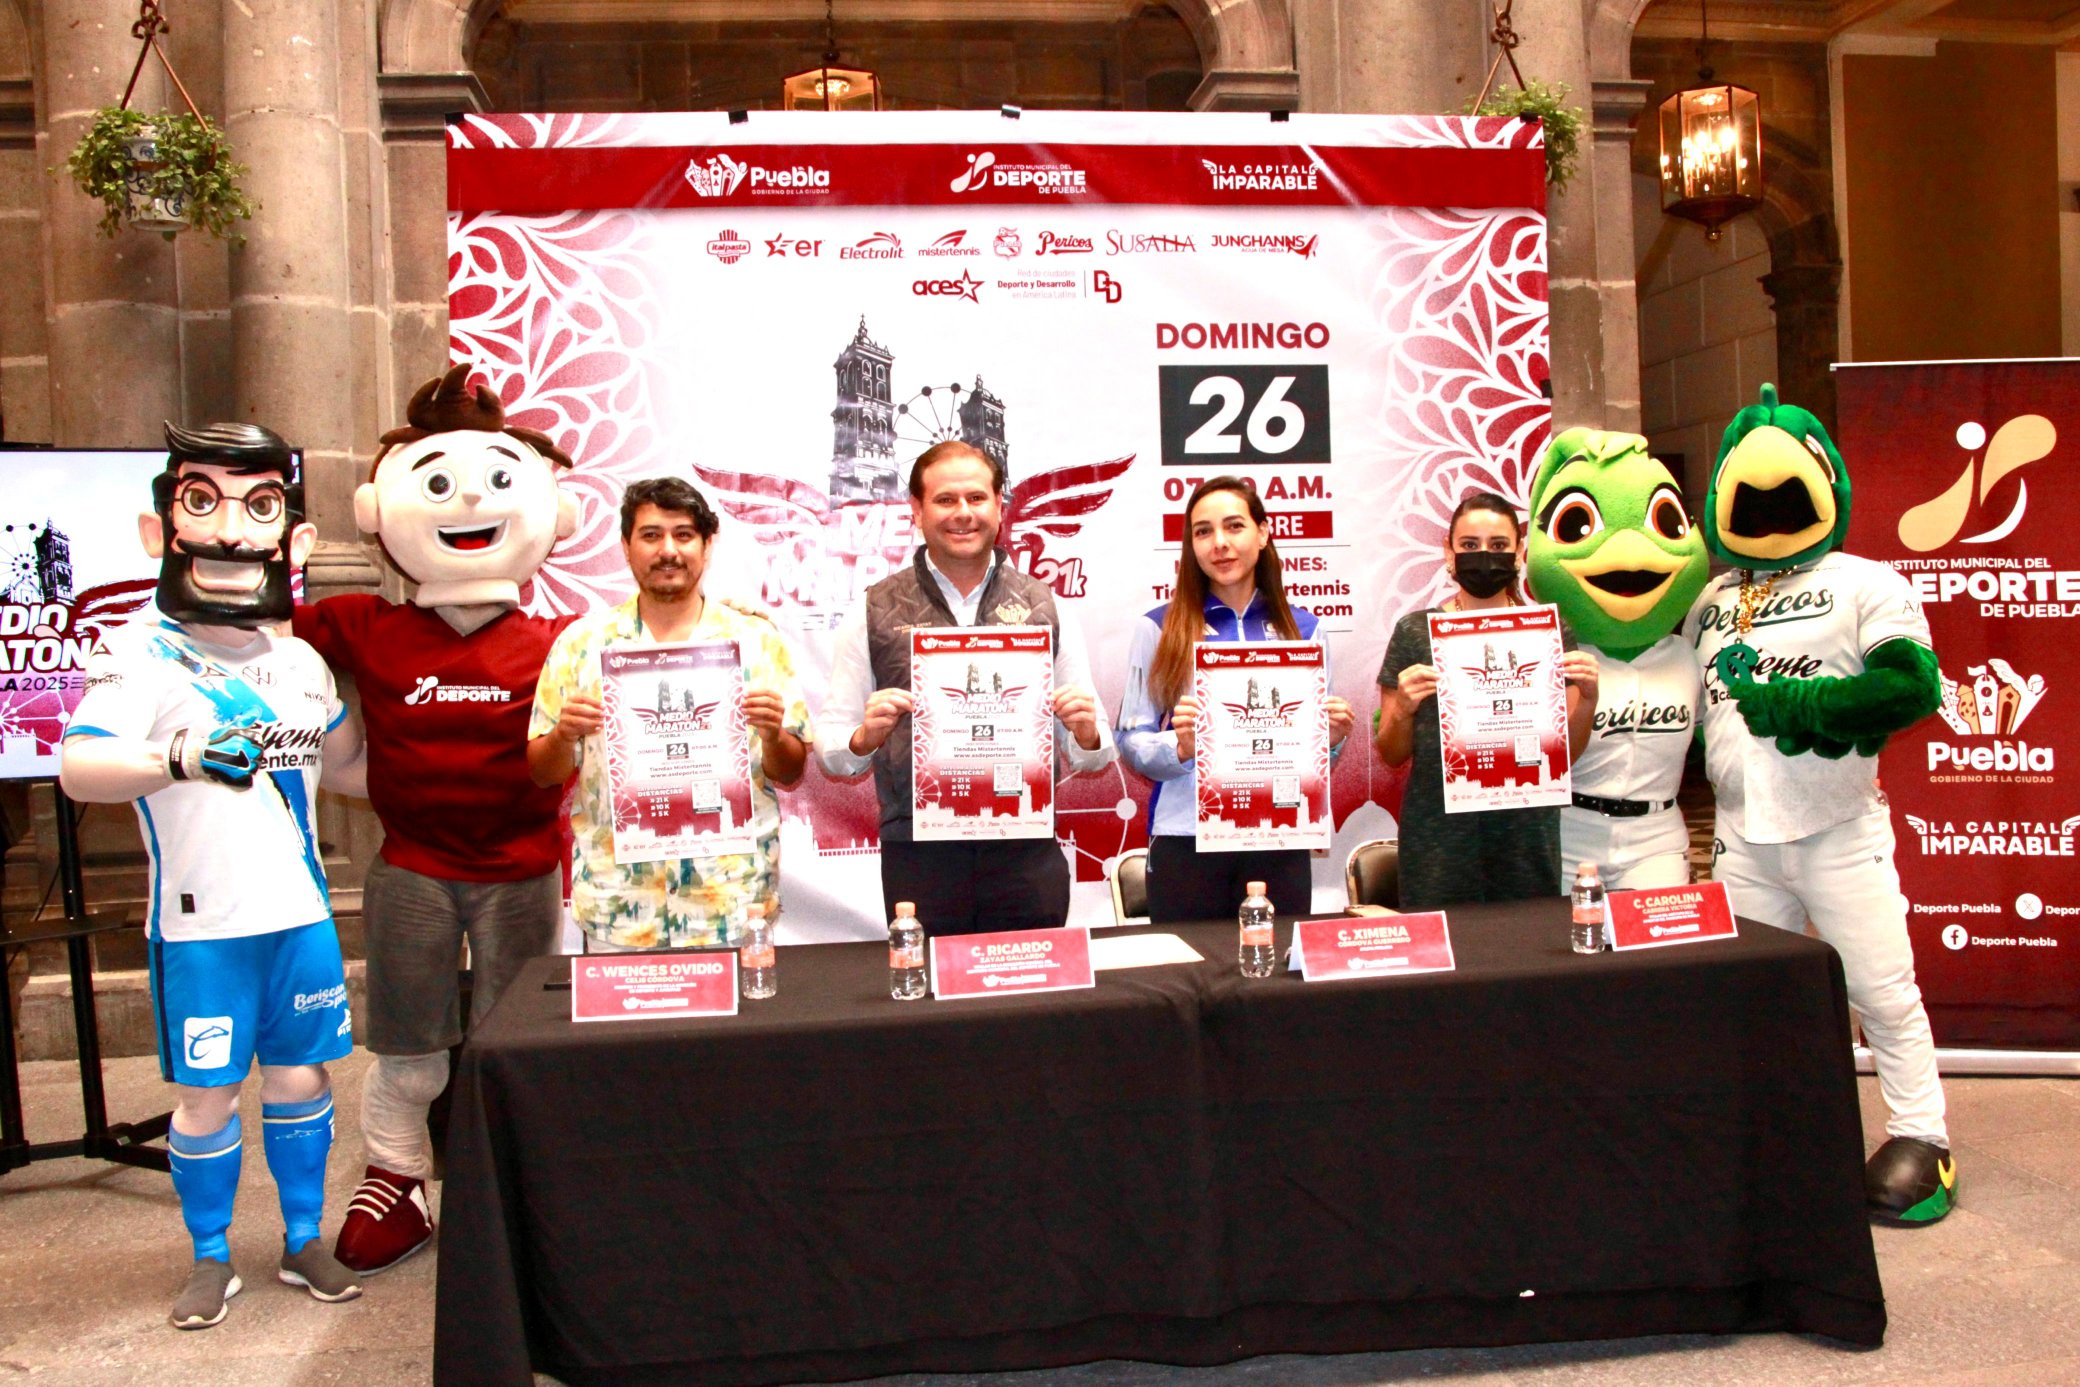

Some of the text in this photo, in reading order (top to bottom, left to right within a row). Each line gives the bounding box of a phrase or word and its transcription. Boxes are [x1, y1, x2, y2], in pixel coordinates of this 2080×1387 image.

[750, 165, 830, 187] Puebla
[1219, 165, 1308, 174] LA CAPITAL
[993, 170, 1086, 186] DEPORTE
[1212, 175, 1318, 190] IMPARABLE
[1038, 186, 1087, 194] DE PUEBLA
[1035, 230, 1094, 256] Pericos
[1211, 234, 1305, 248] JUNGHANNS
[795, 240, 823, 257] er
[839, 246, 905, 260] Electrolit
[918, 247, 981, 257] mistertennis
[912, 279, 964, 296] aces
[997, 280, 1076, 290] Deporte y Desarrollo
[1156, 322, 1330, 350] DOMINGO
[1184, 375, 1306, 455] 26
[1264, 475, 1333, 500] A.M.
[1950, 557, 2023, 569] MUNICIPAL
[2024, 557, 2051, 569] DEL
[1284, 579, 1350, 597] rtennis
[1911, 571, 2080, 602] EPORTE
[1980, 603, 2080, 618] DE PUEBLA
[0, 604, 68, 635] DIO
[22, 676, 68, 691] 2025
[436, 690, 511, 702] DEPORTE
[1495, 700, 1511, 711] 26
[659, 711, 694, 723] MEDIO
[974, 726, 991, 737] 26
[669, 743, 687, 756] 26
[1254, 740, 1271, 750] 26
[1465, 742, 1507, 750] DISTANCIAS
[1927, 740, 2054, 772] Puebla
[1929, 775, 2054, 783] GOBIERNO DE LA CIUDAD
[637, 788, 684, 798] DISTANCIAS
[1930, 821, 2060, 835] LA CAPITAL
[1921, 835, 2075, 856] IMPARABLE
[1633, 892, 1704, 909] C. CAROLINA
[1913, 903, 2002, 915] Deporte Puebla
[2045, 905, 2080, 917] Depor
[1337, 926, 1409, 941] C. XIMENA
[1971, 936, 2058, 948] Deporte Puebla
[970, 941, 1053, 958] C. RICARDO
[585, 962, 724, 978] C. WENCES OVIDIO
